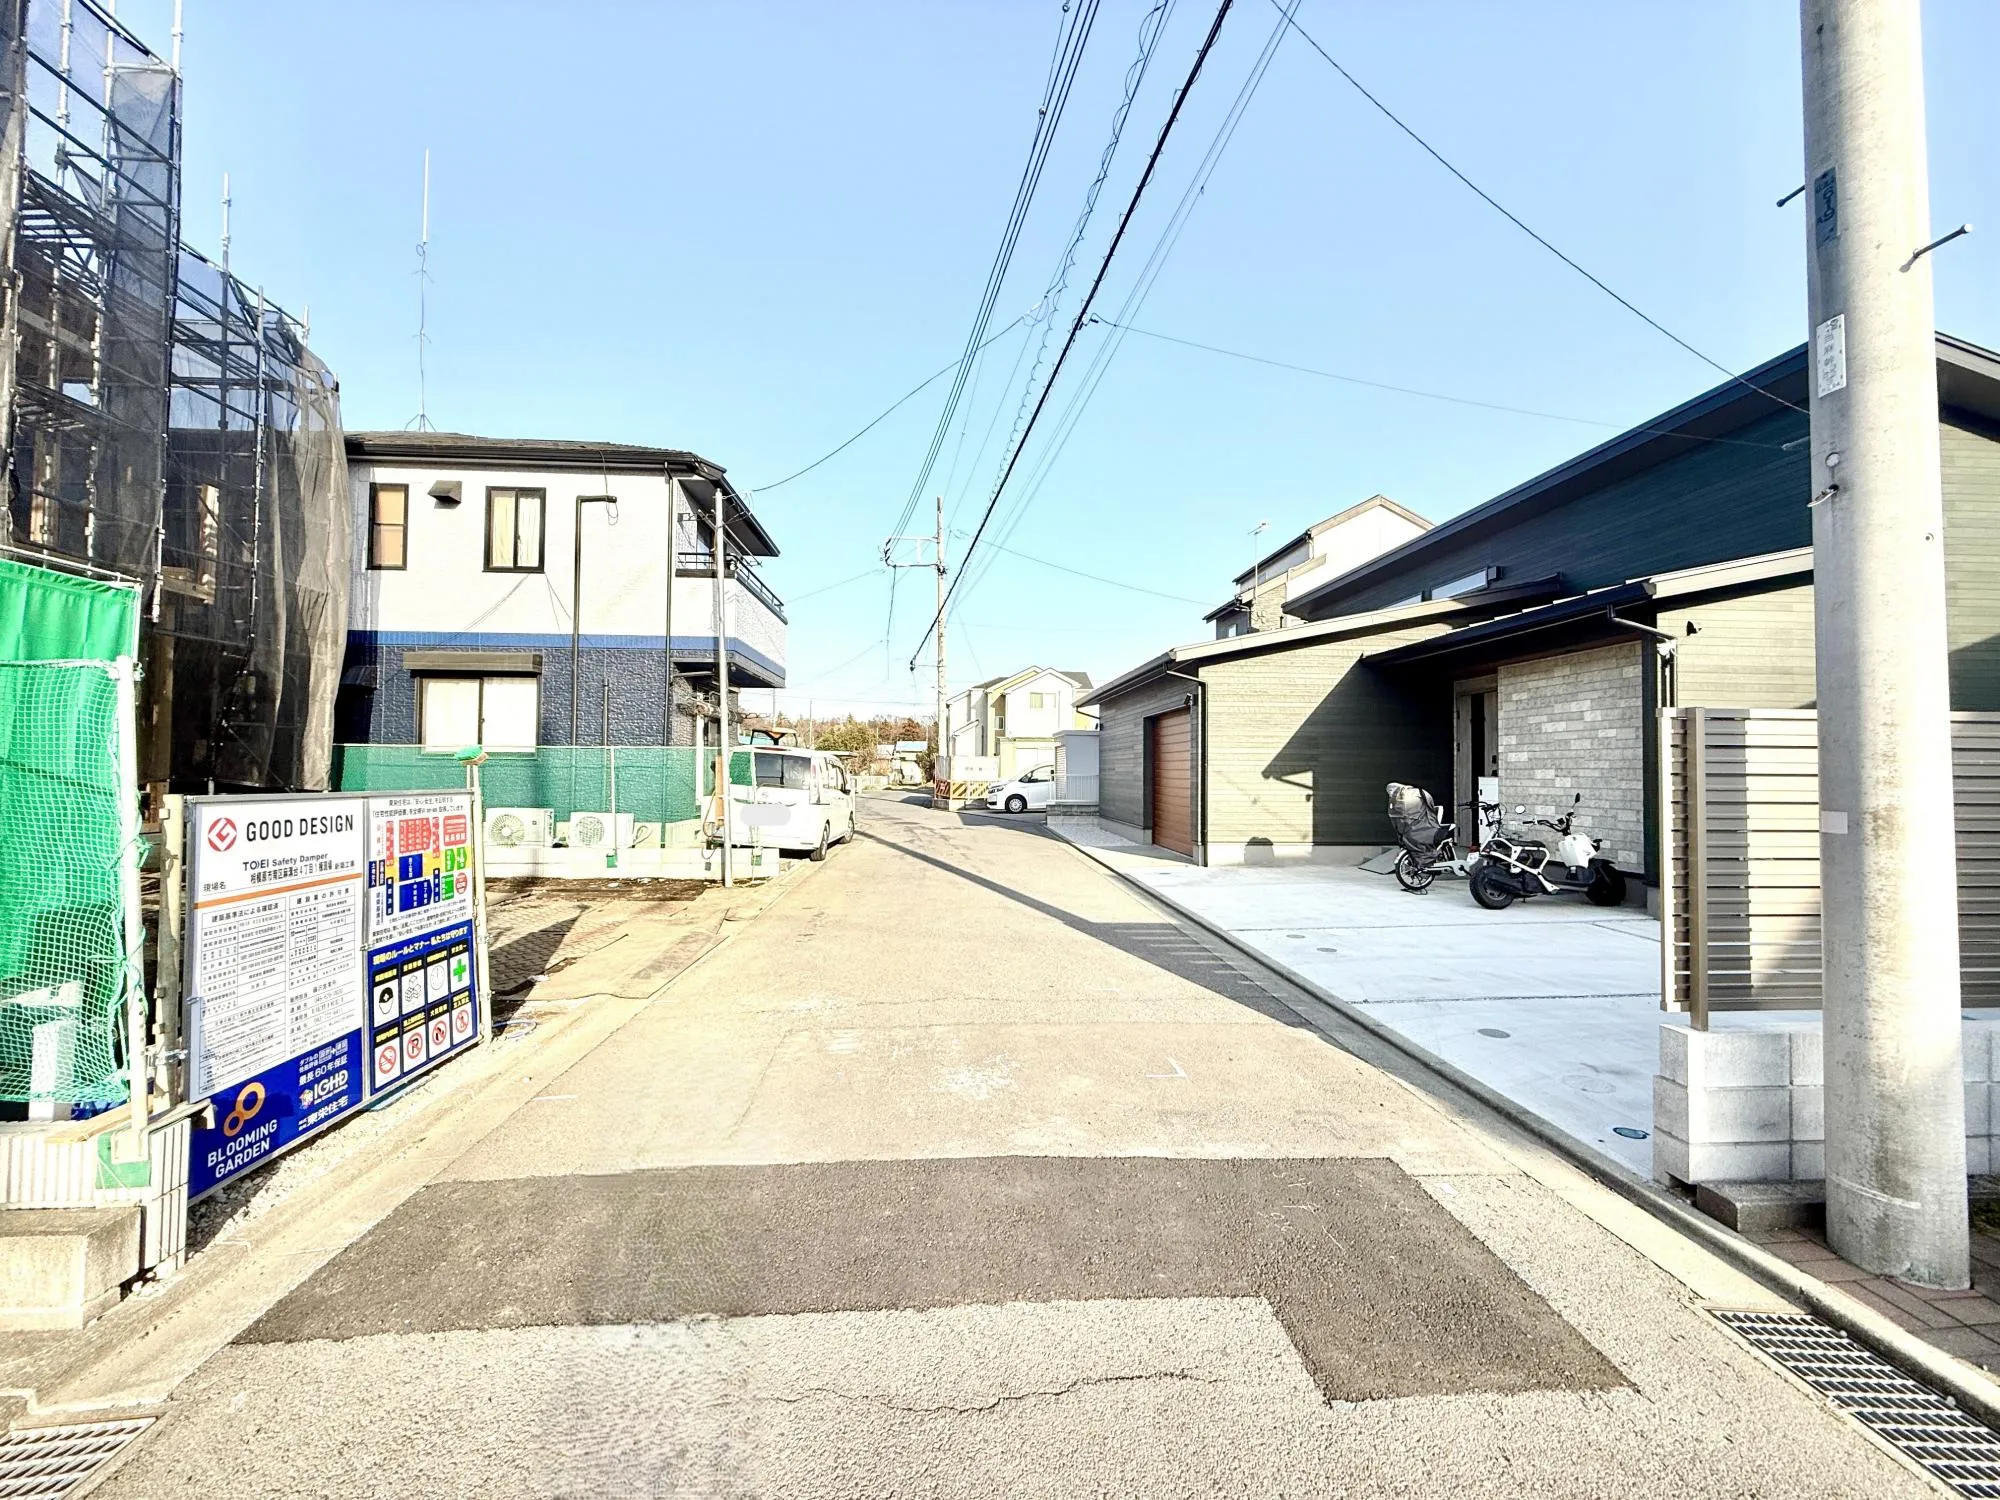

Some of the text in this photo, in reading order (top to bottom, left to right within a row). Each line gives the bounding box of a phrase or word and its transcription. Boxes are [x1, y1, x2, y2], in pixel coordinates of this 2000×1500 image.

[246, 814, 354, 842] GOOD DESIGN
[272, 858, 298, 867] Safety
[299, 853, 328, 863] Damper
[203, 882, 226, 892] 現場名
[299, 1055, 348, 1086] 最長60年保証
[314, 1070, 349, 1099] IGHD
[307, 1095, 348, 1125] 東栄住宅
[207, 1119, 278, 1168] BLOOMING
[215, 1138, 270, 1178] GARDEN
